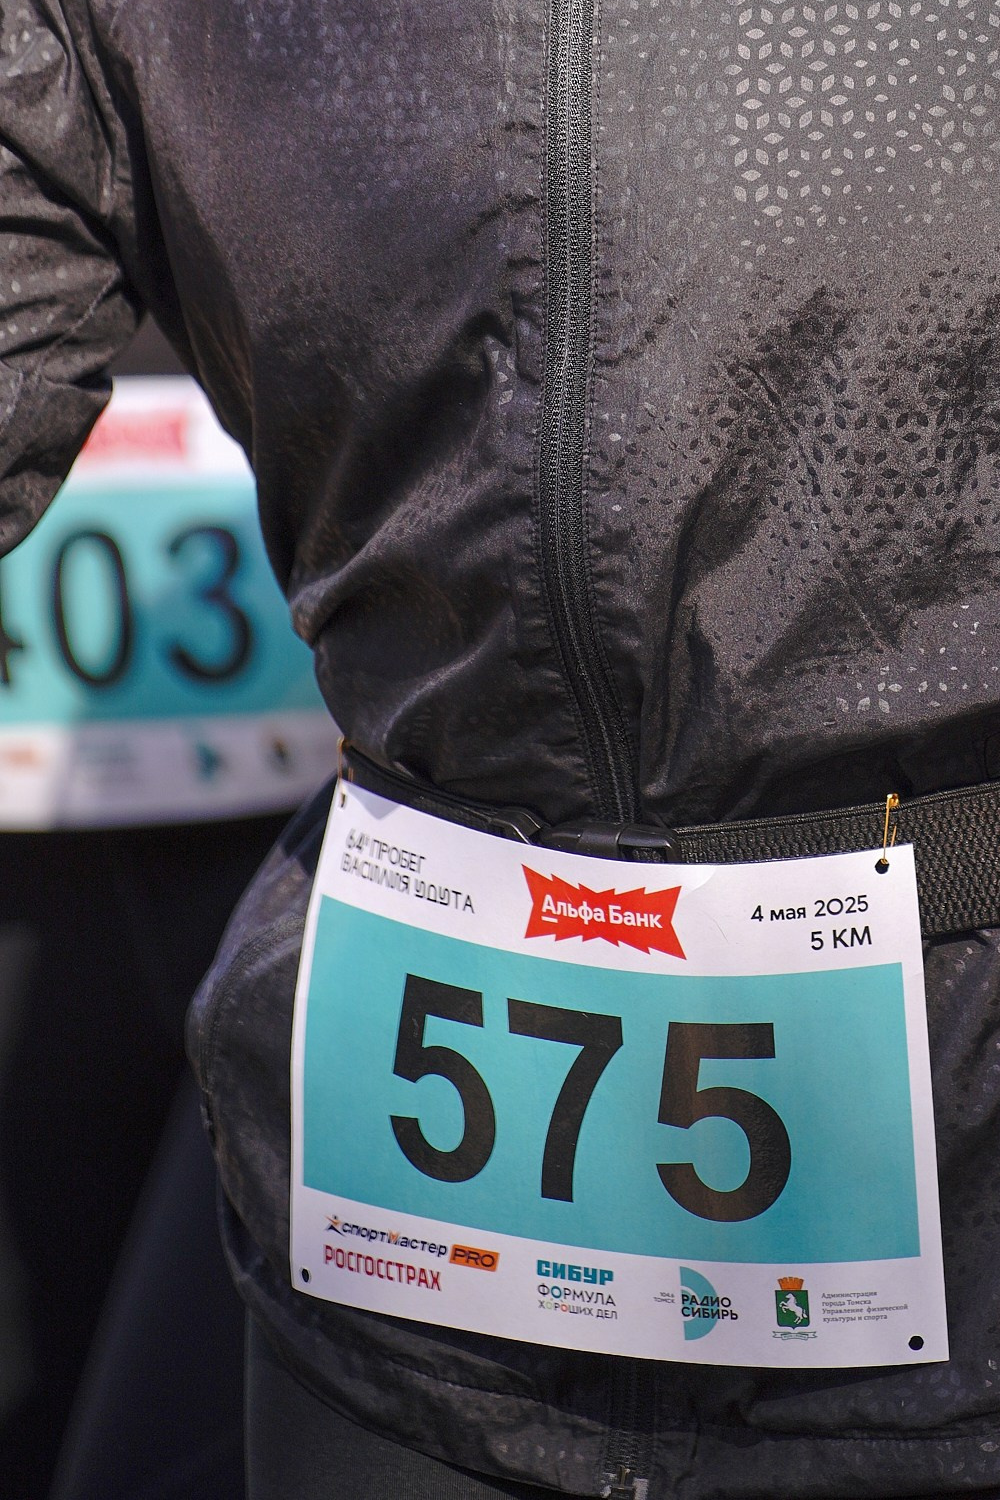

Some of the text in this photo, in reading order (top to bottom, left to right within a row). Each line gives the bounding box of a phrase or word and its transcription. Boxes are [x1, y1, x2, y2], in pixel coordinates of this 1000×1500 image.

[369, 839, 427, 874] ПРОБЕГ
[340, 851, 411, 895] ВАСИЛИЯ
[541, 894, 664, 929] Альфа Банк
[750, 894, 869, 922] 4 мая 2025
[810, 925, 872, 951] 5 КМ
[388, 973, 792, 1223] 575
[323, 1244, 442, 1292] РОСГОССТРАХ
[451, 1246, 497, 1269] PRO
[536, 1259, 614, 1286] СИБУР
[537, 1282, 617, 1307] ФОРМУЛА
[681, 1293, 732, 1308] РАДИО
[821, 1291, 878, 1299] Администрация
[537, 1299, 618, 1320] ХОРОШИХ ДЕЛ
[681, 1306, 739, 1321] СИБИРЬ
[822, 1303, 909, 1315] Управление физической
[822, 1315, 857, 1324] культуры
[863, 1314, 888, 1322] спорта
